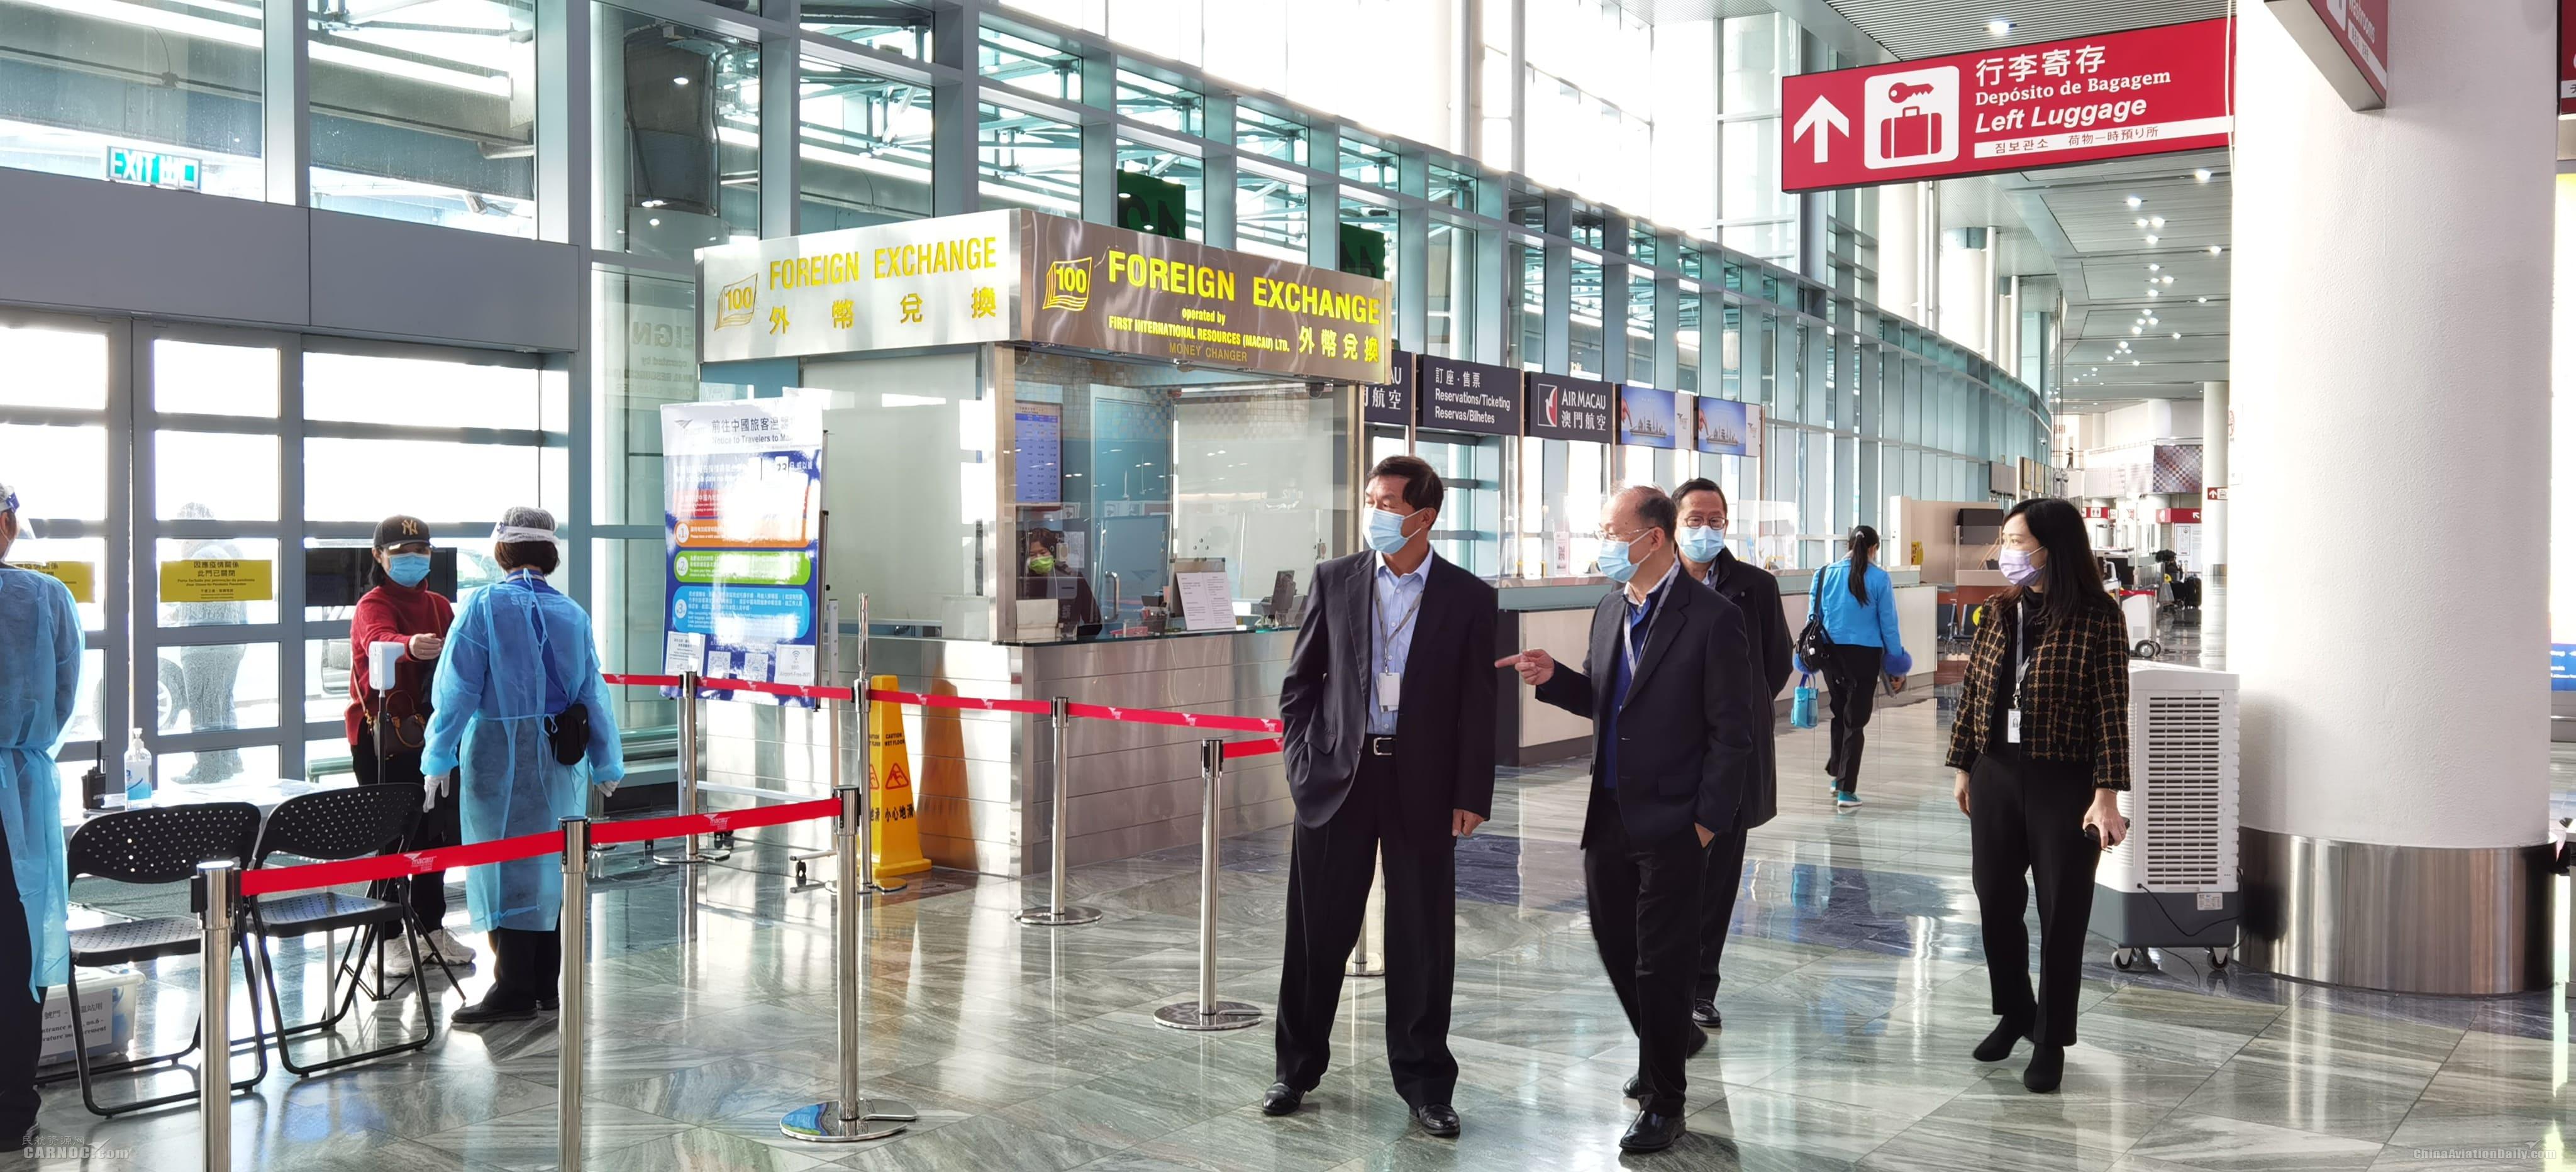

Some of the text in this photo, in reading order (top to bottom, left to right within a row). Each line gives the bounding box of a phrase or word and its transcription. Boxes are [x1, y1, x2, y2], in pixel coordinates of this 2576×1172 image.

[1975, 45, 2106, 87] 行李寄存
[1975, 71, 2171, 106] Depósito de Bagagem
[1975, 99, 2147, 133] Left Luggage
[1995, 139, 2048, 154] 짐보관소
[2068, 126, 2158, 146] 荷物一時預り所
[109, 147, 157, 182] EXIT
[770, 236, 997, 290] FOREIGN EXCHANGE
[1056, 266, 1087, 294] 100
[1109, 250, 1380, 325] FOREIGN EXCHANGE
[725, 286, 752, 312] 100
[769, 287, 997, 335] 外幣兌換
[1182, 307, 1226, 326] operated by
[1109, 316, 1290, 352] FIRST INTERNATIONAL RESOURCES (MACAU) LTD.
[1299, 326, 1379, 362] 外幣兌換
[1169, 342, 1248, 363] MONEY CHANGER
[1435, 387, 1511, 412] Reservations/Ticketing
[1562, 388, 1606, 411] AIR MACAU
[1435, 406, 1496, 424] Reservas/Bilhetes
[1562, 409, 1606, 431] 澳門航空
[741, 434, 770, 444] Travelers
[772, 434, 779, 442] to
[402, 519, 418, 535] NY
[885, 803, 914, 822] 小心地滑
